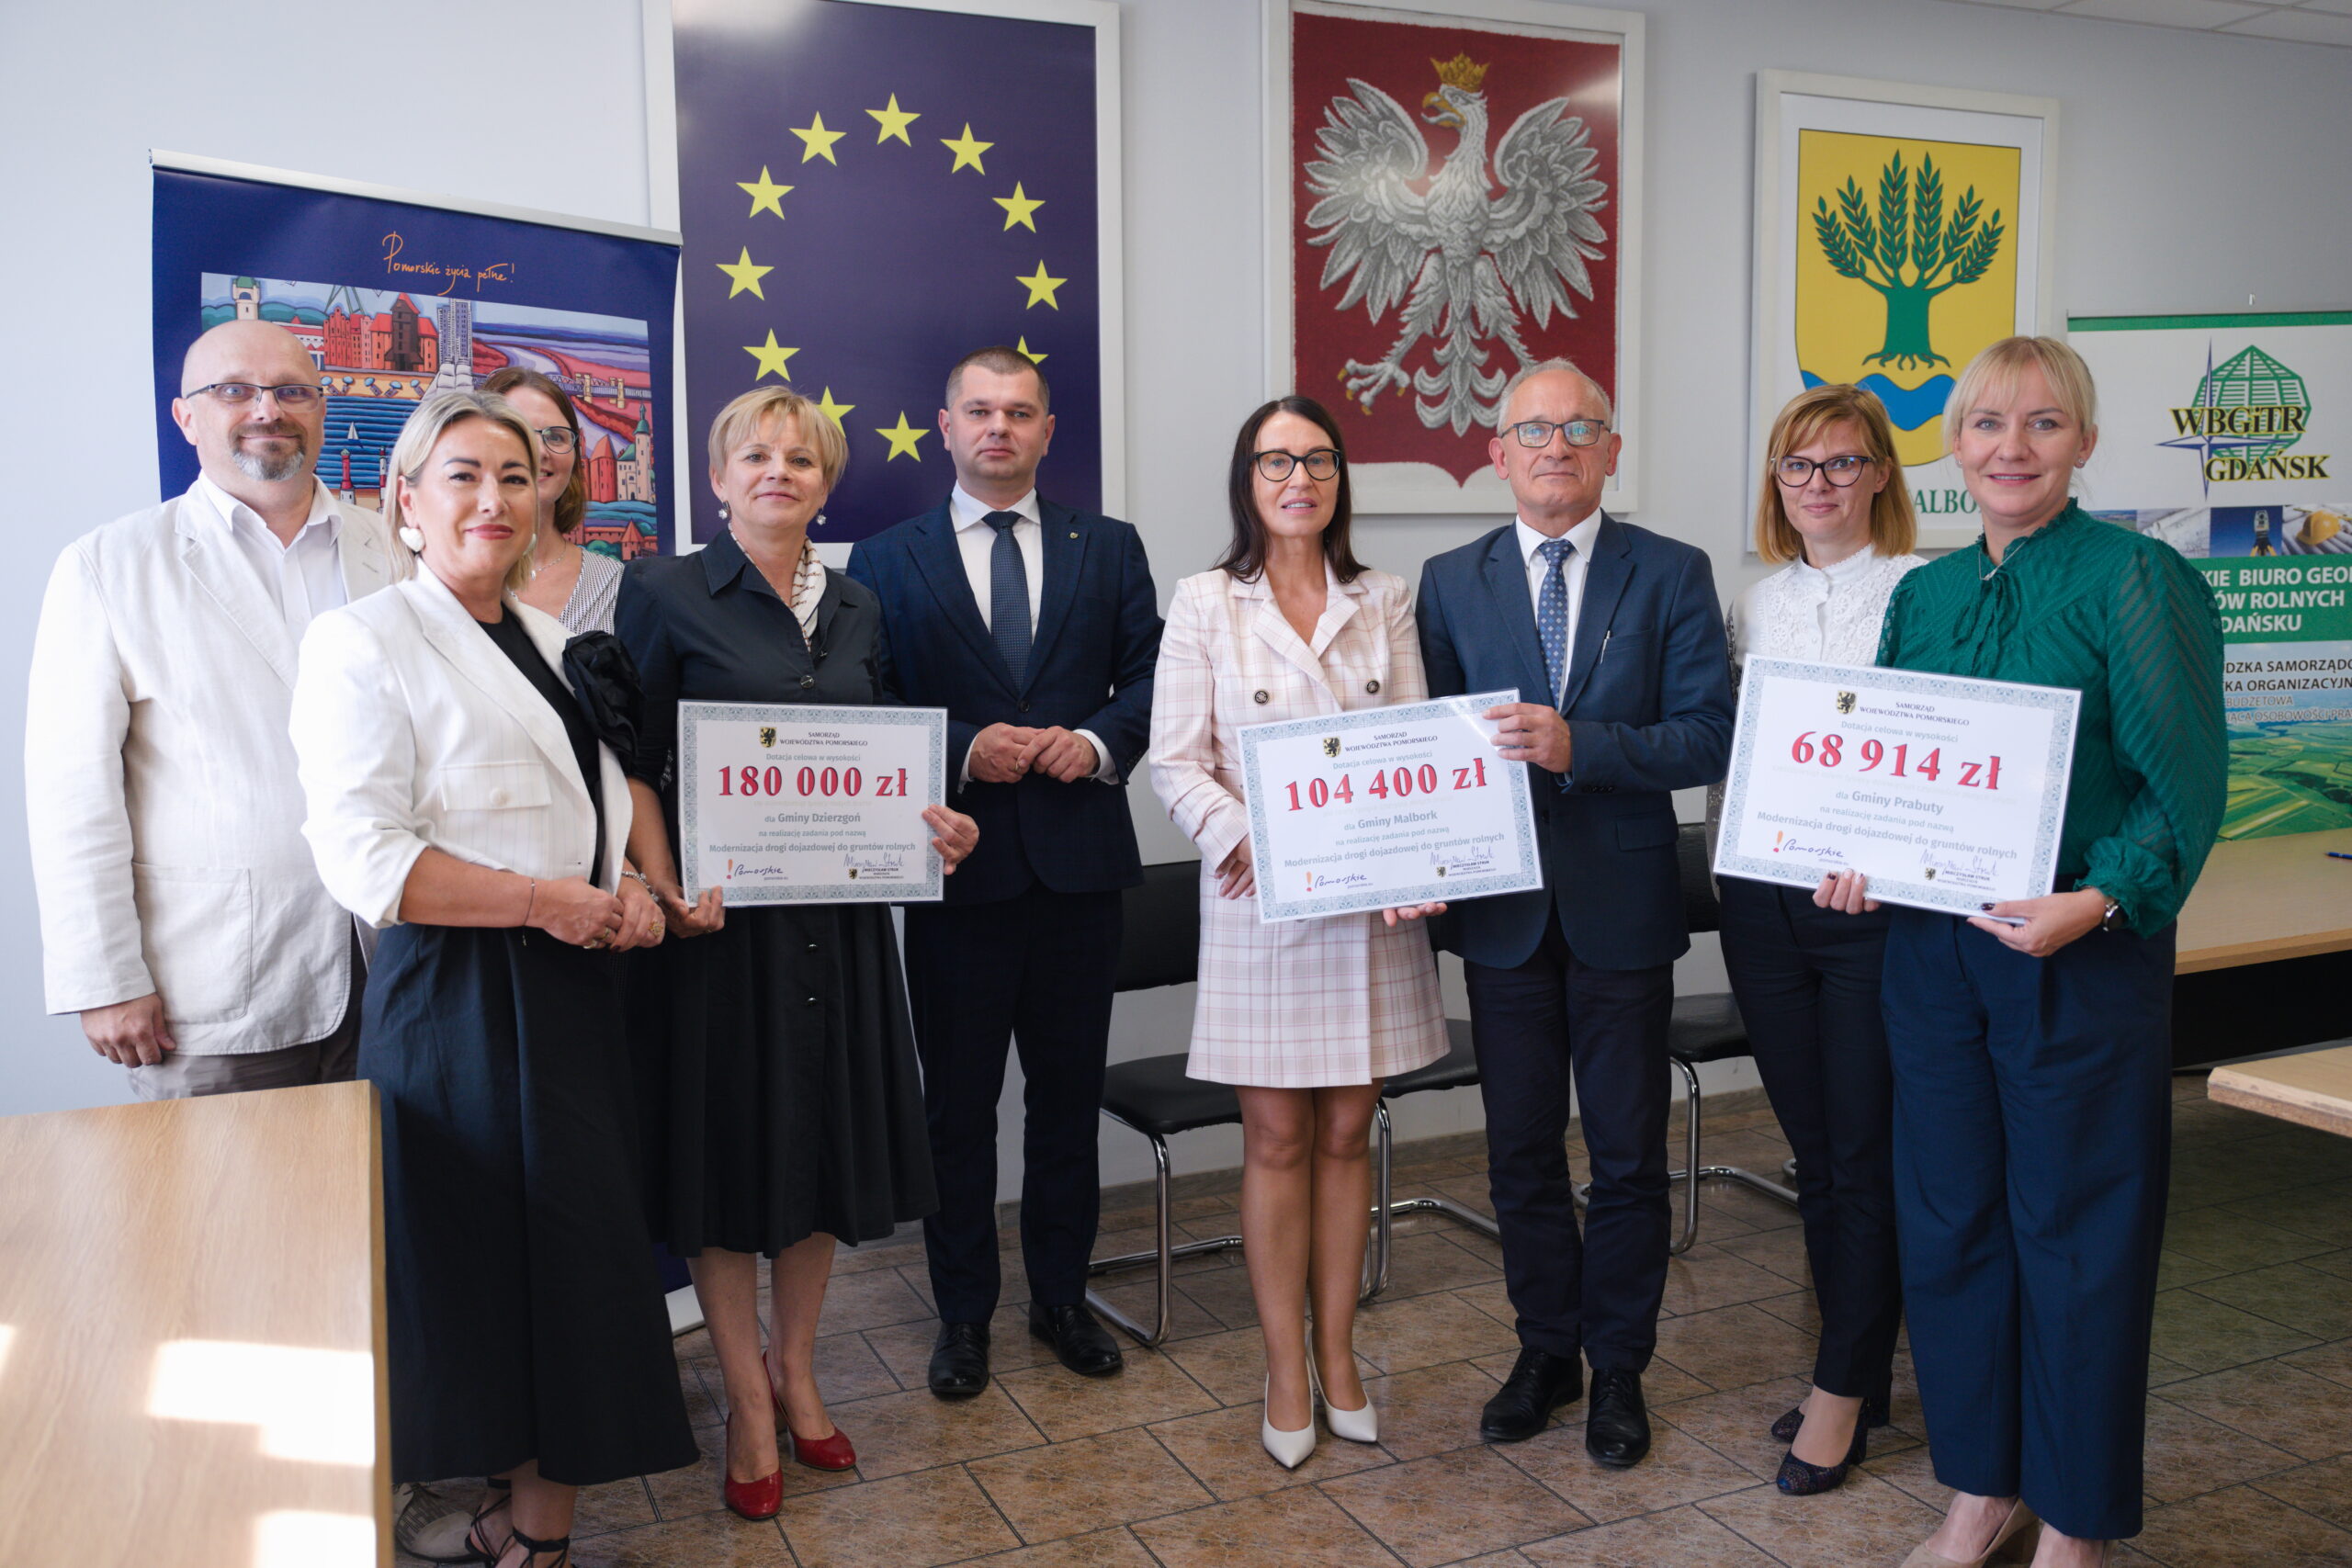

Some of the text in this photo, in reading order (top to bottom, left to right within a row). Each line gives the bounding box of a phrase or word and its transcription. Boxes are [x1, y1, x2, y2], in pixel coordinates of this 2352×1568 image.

[382, 231, 440, 275] Pomorskie
[437, 265, 471, 296] życia
[2169, 405, 2306, 435] WBGiTR
[2205, 450, 2331, 482] GDAŃSK
[1909, 489, 1981, 514] ALBO
[2239, 568, 2301, 587] BIURO
[2306, 566, 2352, 584] GEO
[2250, 590, 2345, 609] ROLNYCH
[1916, 714, 1970, 726] POMORSKIEGO
[2332, 708, 2352, 718] PRA
[1393, 736, 1438, 746] POMORSKIEGO
[1841, 721, 1872, 731] Dotacja
[1874, 726, 1904, 736] celowa
[1915, 730, 1959, 743] wysokości
[766, 753, 792, 761] Dotacja
[1333, 761, 1361, 770] Dotacja
[1362, 757, 1387, 765] celowa
[1396, 750, 1432, 761] wysokości
[1792, 731, 2002, 791] 68 914 zł
[718, 765, 909, 796] 180 000 zł
[1284, 757, 1487, 811] 104 400 zł
[1836, 791, 1944, 816] dla Gminy Prabuty
[778, 812, 809, 825] Gminy
[812, 812, 861, 824] Dzierzgoń
[1358, 817, 1391, 829] Gminy
[1394, 810, 1438, 825] Malbork
[1832, 807, 1871, 820] realizację
[1873, 813, 1905, 825] zadania
[1908, 818, 1925, 828] pod
[1928, 822, 1954, 833] nazwą
[768, 829, 801, 838] realizację
[1346, 835, 1380, 845] realizację
[1382, 830, 1409, 840] zadania
[1411, 829, 1425, 838] pod
[1758, 811, 2018, 859] Modernizacja drogi dojazdowej do gruntów rolnych
[709, 843, 763, 853] Modernizacja
[764, 843, 786, 853] drogi
[788, 842, 835, 852] dojazdowej
[850, 842, 883, 852] gruntów
[886, 842, 915, 852] rolnych
[1284, 852, 1342, 867] Modernizacja
[1344, 849, 1367, 861] drogi
[1369, 842, 1419, 857] dojazdowej
[1420, 841, 1432, 851] do
[1434, 838, 1470, 850] gruntów
[1472, 832, 1504, 844] rolnych
[1783, 839, 1843, 858] Pomorskie
[734, 863, 783, 876] Pomorskie
[1315, 873, 1367, 888] Pomorskie
